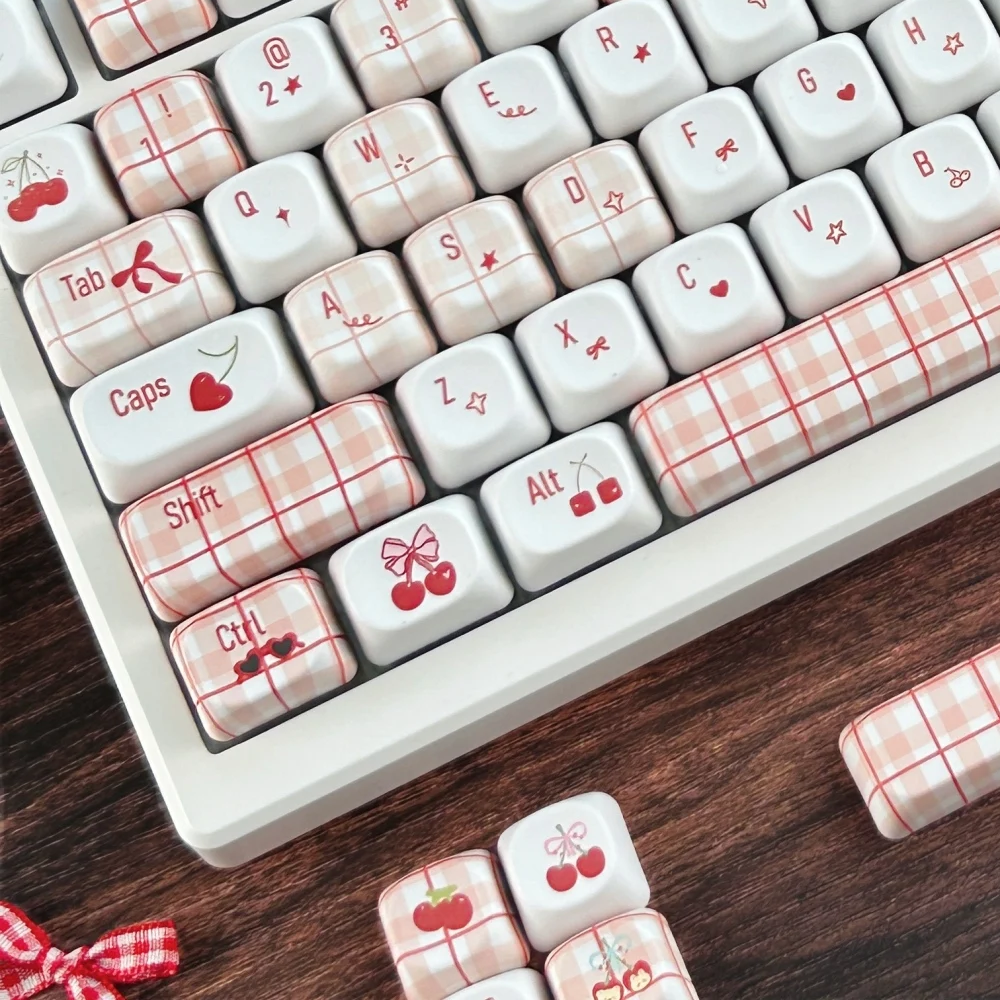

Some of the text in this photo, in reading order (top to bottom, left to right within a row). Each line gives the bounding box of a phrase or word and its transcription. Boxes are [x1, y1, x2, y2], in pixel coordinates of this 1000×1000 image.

[380, 25, 400, 50] 3
[596, 26, 619, 52] R
[903, 17, 926, 44] H
[263, 37, 291, 70] @
[259, 81, 279, 107] 2
[478, 81, 500, 107] E
[798, 68, 817, 94] G
[157, 93, 172, 118] !
[354, 133, 380, 163] W
[681, 121, 697, 148] F
[140, 138, 151, 160] 1
[913, 150, 934, 177] B
[235, 191, 259, 217] Q
[564, 177, 585, 204] D
[793, 205, 813, 232] V
[441, 234, 460, 260] S
[60, 267, 104, 301] Tab
[677, 264, 696, 289] C
[321, 291, 341, 319] A
[554, 320, 578, 348] X
[109, 376, 170, 417] Caps
[434, 377, 455, 404] Z
[527, 469, 564, 505] Alt
[163, 485, 223, 530] Shift
[215, 610, 266, 653] Ctrl
